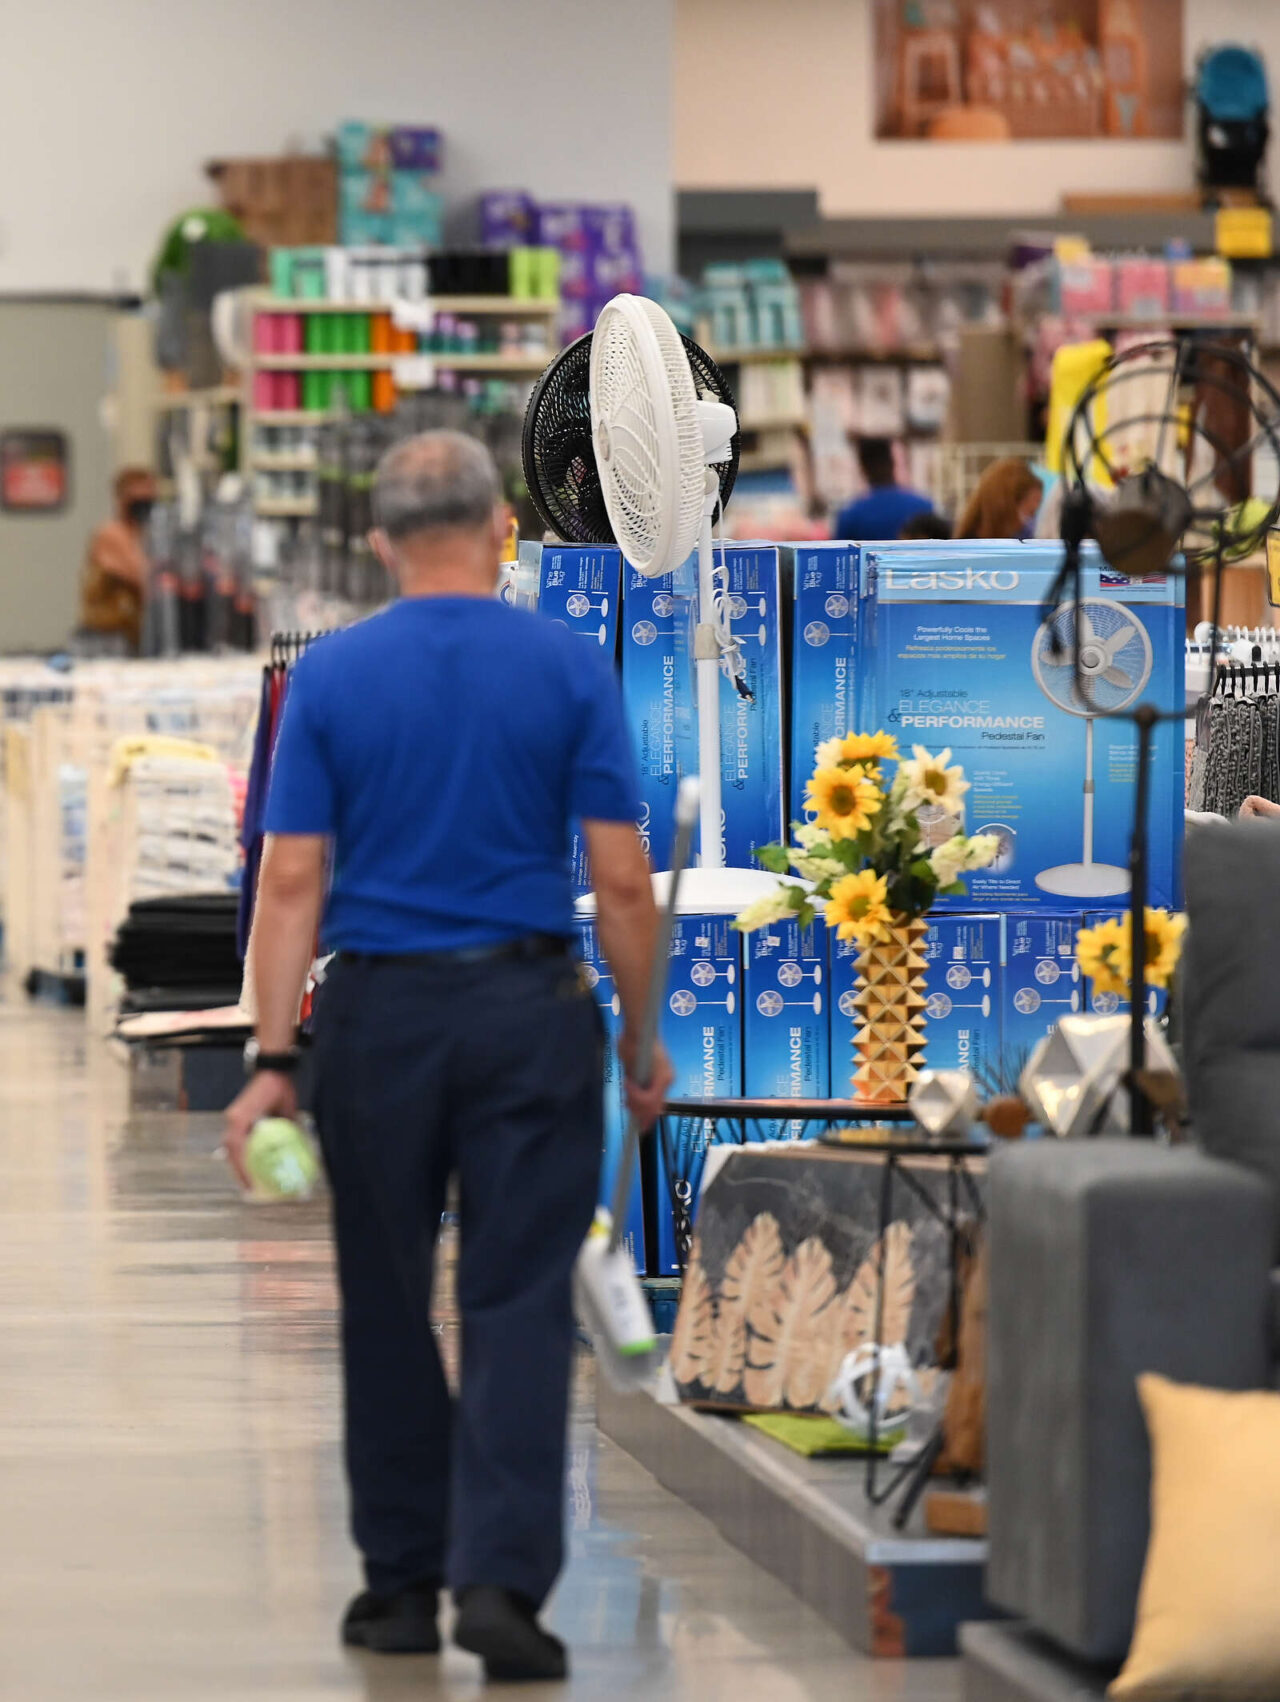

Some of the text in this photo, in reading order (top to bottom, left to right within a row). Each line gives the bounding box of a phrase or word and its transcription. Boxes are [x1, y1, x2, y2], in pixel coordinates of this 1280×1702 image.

[885, 567, 1020, 590] Lasko
[913, 634, 941, 642] Largest
[916, 625, 953, 634] Powerfully
[954, 625, 975, 633] Cools
[835, 657, 847, 738] ORMANCE
[917, 689, 969, 699] Adjustable
[898, 699, 991, 714] ELEGANCE
[657, 655, 674, 786] & PERFORMANCE
[887, 708, 1045, 729] & PERFORMANCE
[640, 719, 651, 762] Adjustable
[649, 700, 662, 776] ELEGANCE
[723, 703, 736, 782] ELEGANCE
[981, 731, 1045, 741] Pedestal Fan
